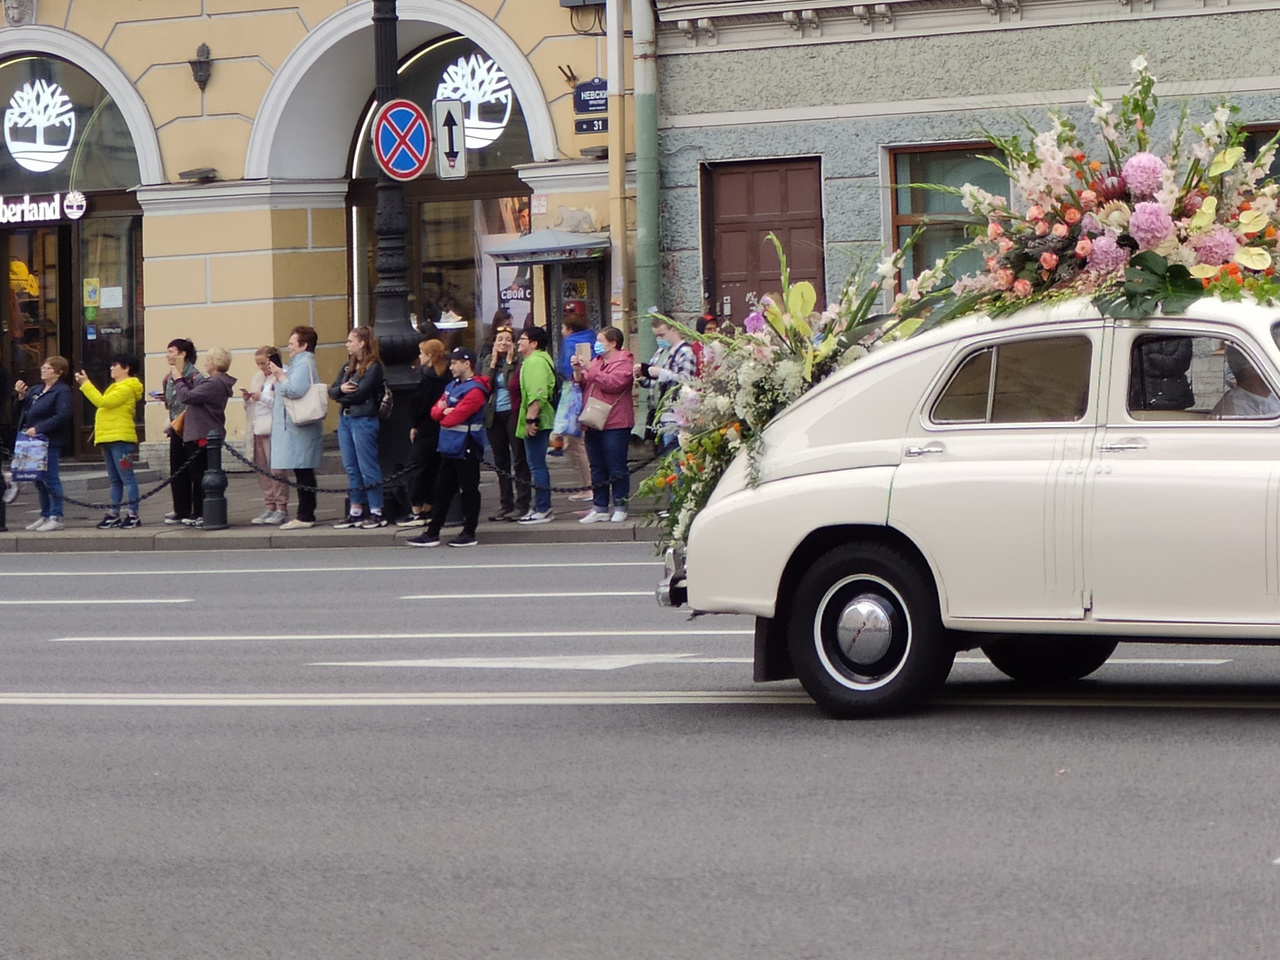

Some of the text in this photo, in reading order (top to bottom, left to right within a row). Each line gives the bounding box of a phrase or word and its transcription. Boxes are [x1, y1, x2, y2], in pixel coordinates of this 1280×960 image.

[580, 90, 607, 100] НЕВСКИ
[593, 120, 603, 131] 31
[501, 288, 524, 300] СВОЙ
